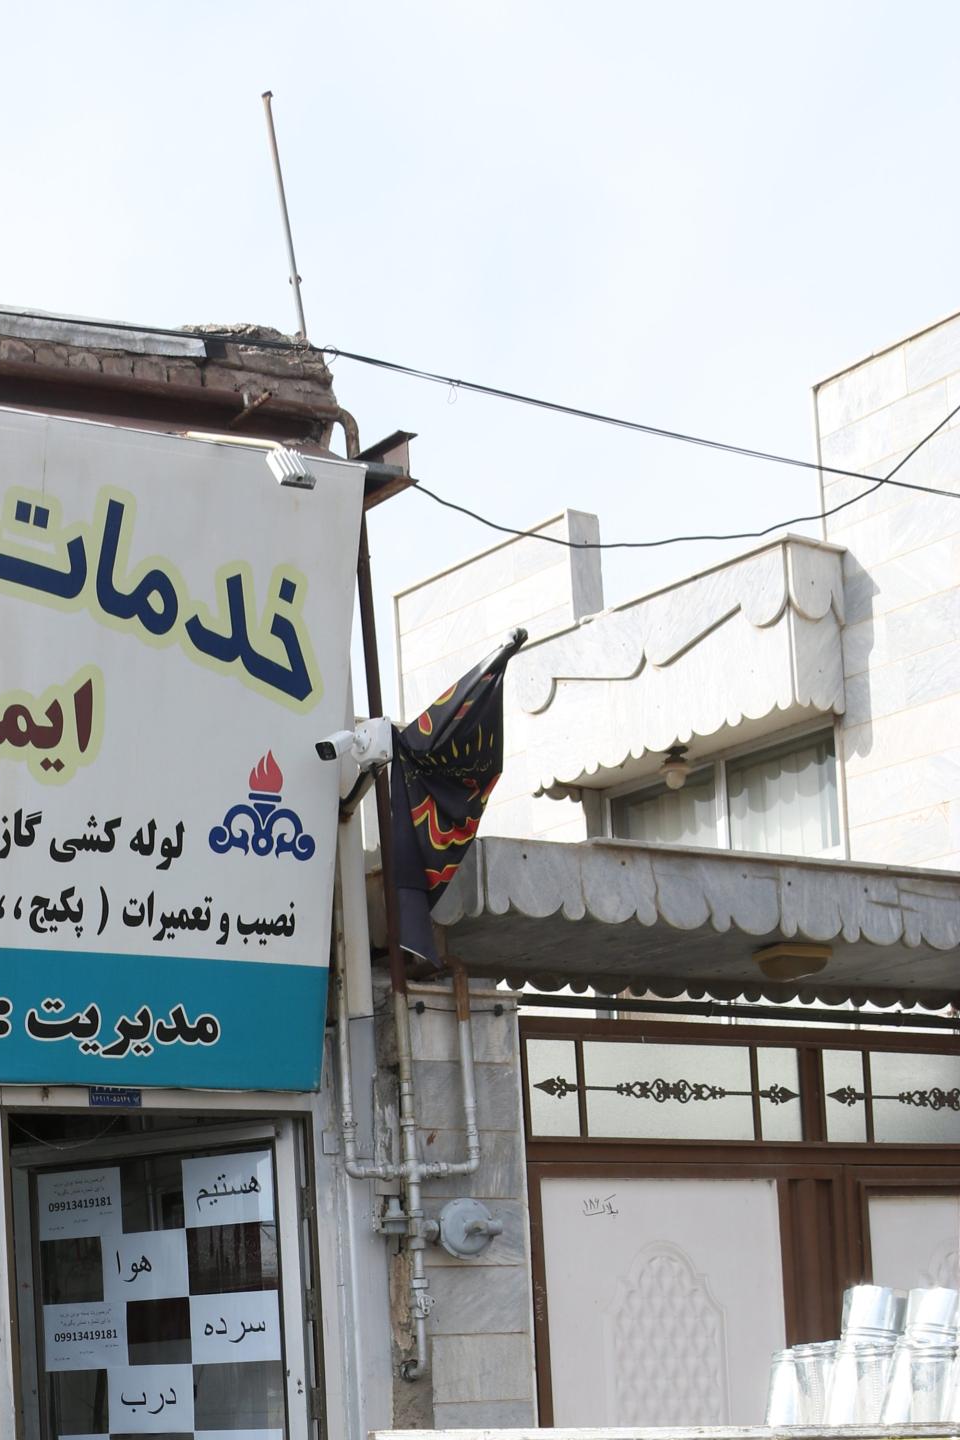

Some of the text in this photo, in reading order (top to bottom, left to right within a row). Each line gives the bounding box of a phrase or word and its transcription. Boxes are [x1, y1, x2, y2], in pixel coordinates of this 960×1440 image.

[49, 814, 123, 863] کشی
[128, 817, 186, 871] لوله
[28, 886, 85, 938] پکیج
[121, 890, 213, 941] تعمیرات
[215, 911, 231, 945] و
[23, 997, 221, 1056] مدیریت
[48, 1195, 113, 1213] 09913419181
[195, 1172, 262, 1211] هستیم
[115, 1250, 153, 1283] هوا
[54, 1329, 118, 1343] 09913419181
[203, 1316, 267, 1344] سرده
[120, 1386, 177, 1414] درب
